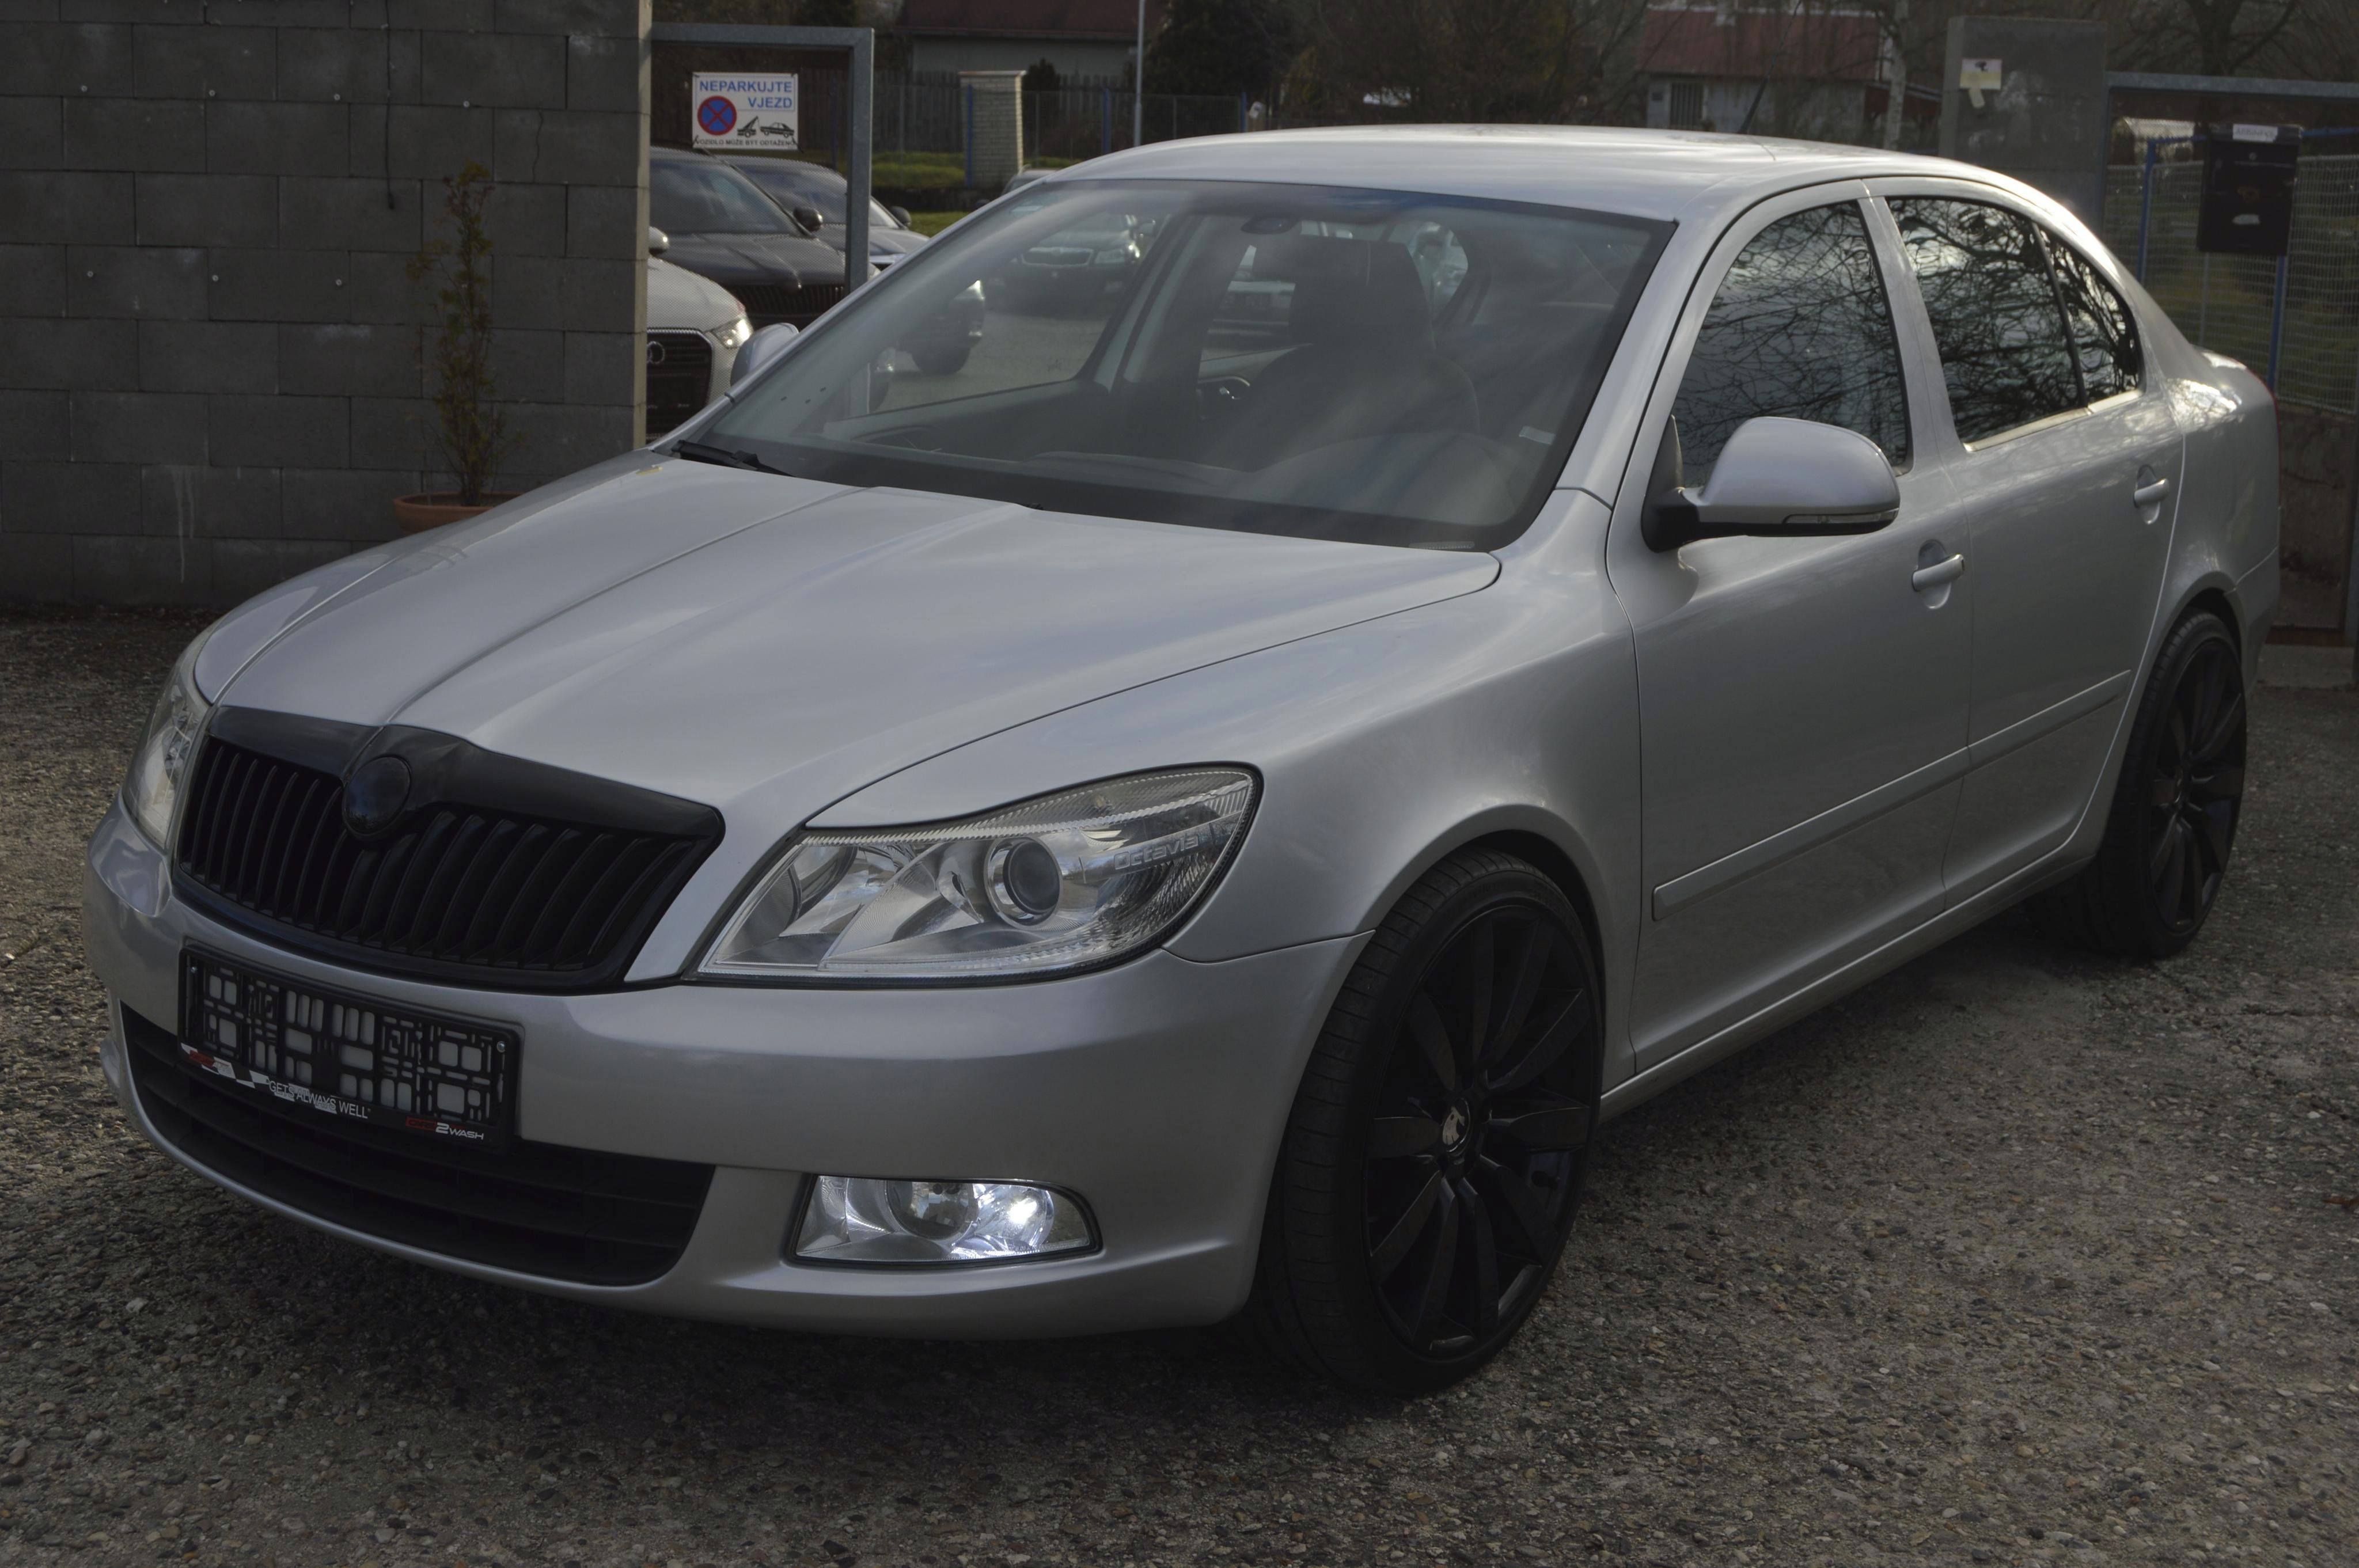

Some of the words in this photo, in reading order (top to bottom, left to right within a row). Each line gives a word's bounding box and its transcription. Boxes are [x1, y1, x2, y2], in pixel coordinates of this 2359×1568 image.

[700, 81, 792, 92] NEPARKUJTE
[748, 97, 792, 108] VJEZD
[1114, 835, 1199, 870] Octavia
[296, 1088, 336, 1110] ALWAYS
